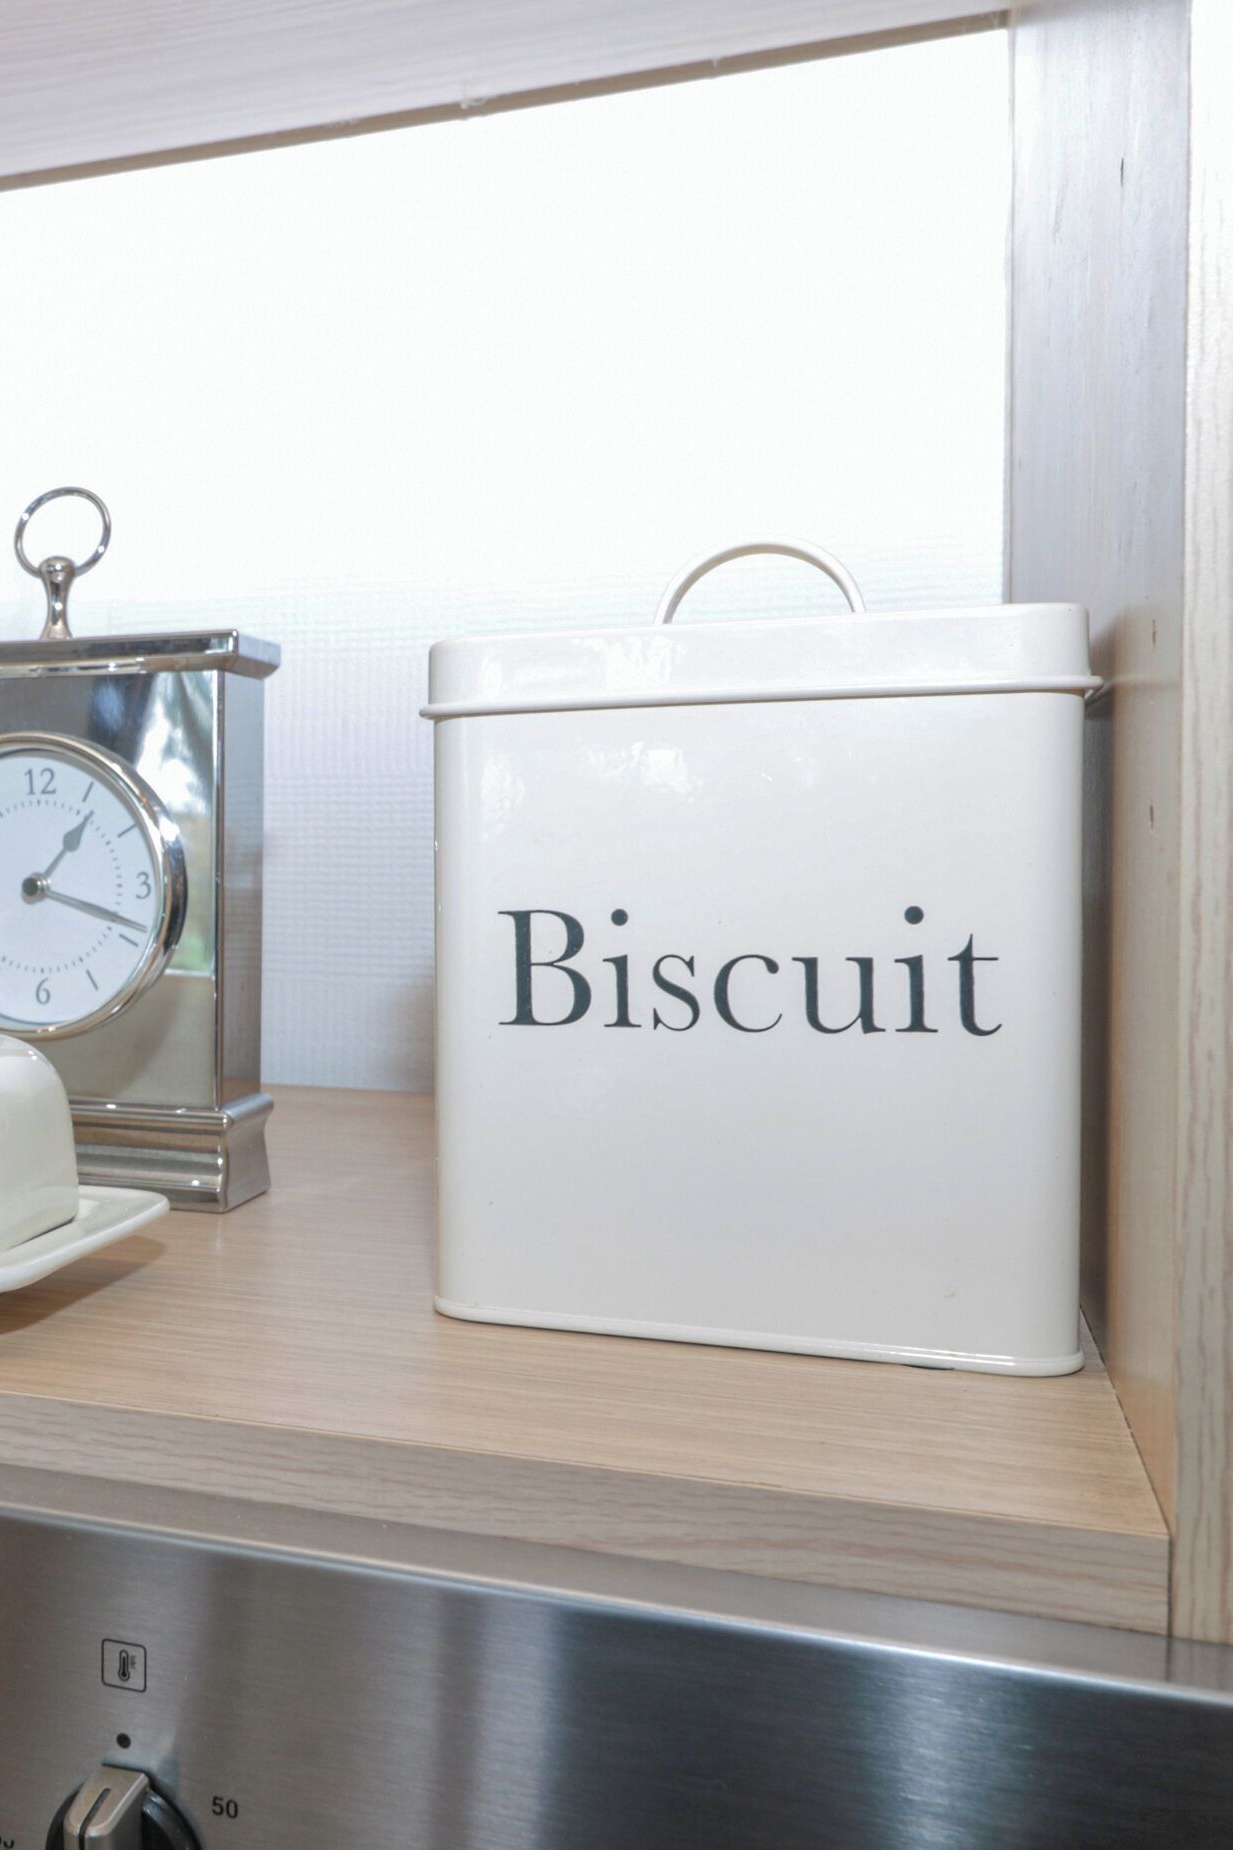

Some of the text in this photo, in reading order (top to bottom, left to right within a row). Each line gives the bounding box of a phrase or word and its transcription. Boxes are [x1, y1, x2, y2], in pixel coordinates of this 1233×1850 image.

[23, 767, 57, 796] 12
[135, 871, 152, 899] 3
[497, 906, 1003, 1037] Biscuit
[35, 977, 51, 1005] 6
[212, 1796, 239, 1820] 50
